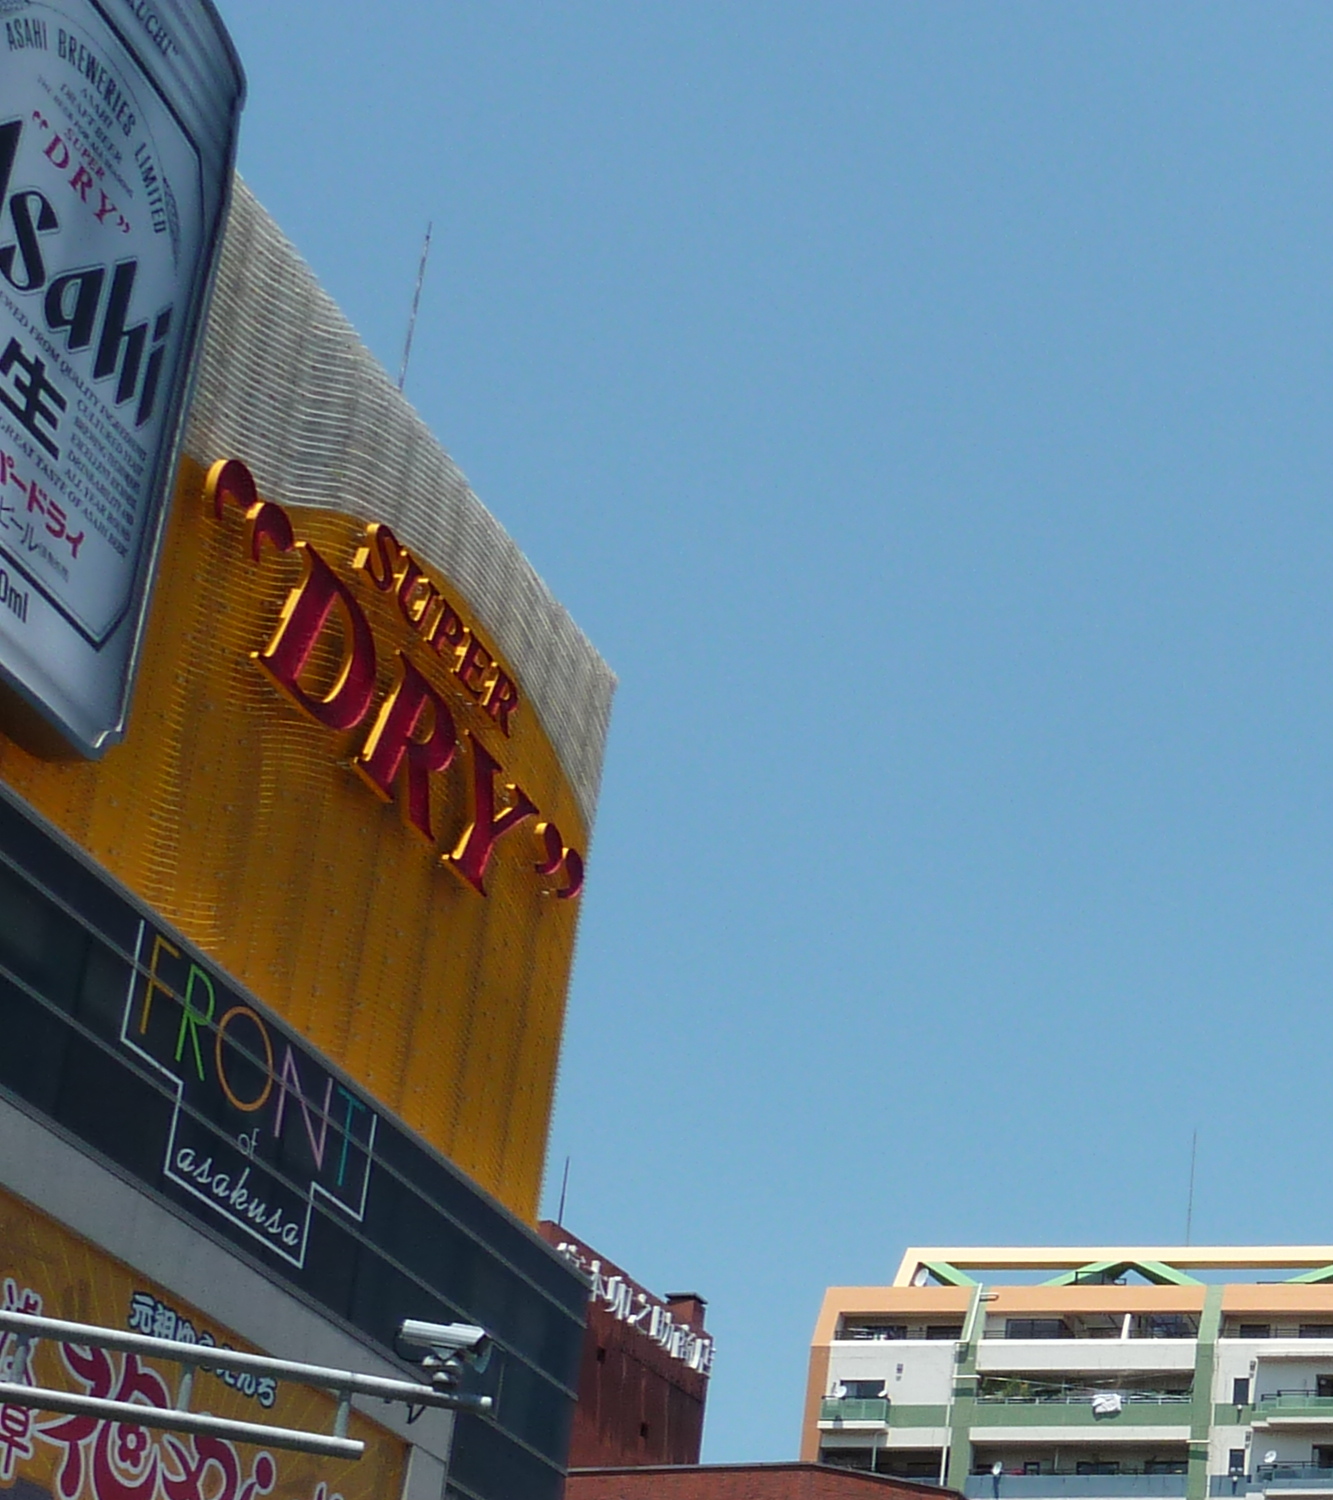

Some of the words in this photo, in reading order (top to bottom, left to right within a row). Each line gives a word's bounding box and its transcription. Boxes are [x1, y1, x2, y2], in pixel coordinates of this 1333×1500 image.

[6, 18, 48, 51] ASAHI
[58, 28, 136, 137] BREWERIES
[135, 142, 166, 235] LIMITED
[64, 128, 107, 181] SUPER
[0, 336, 68, 461] 生
[353, 522, 518, 737] SUPER
[139, 933, 367, 1187] FRONT
[176, 1146, 302, 1249] asakusa
[237, 1127, 259, 1158] of
